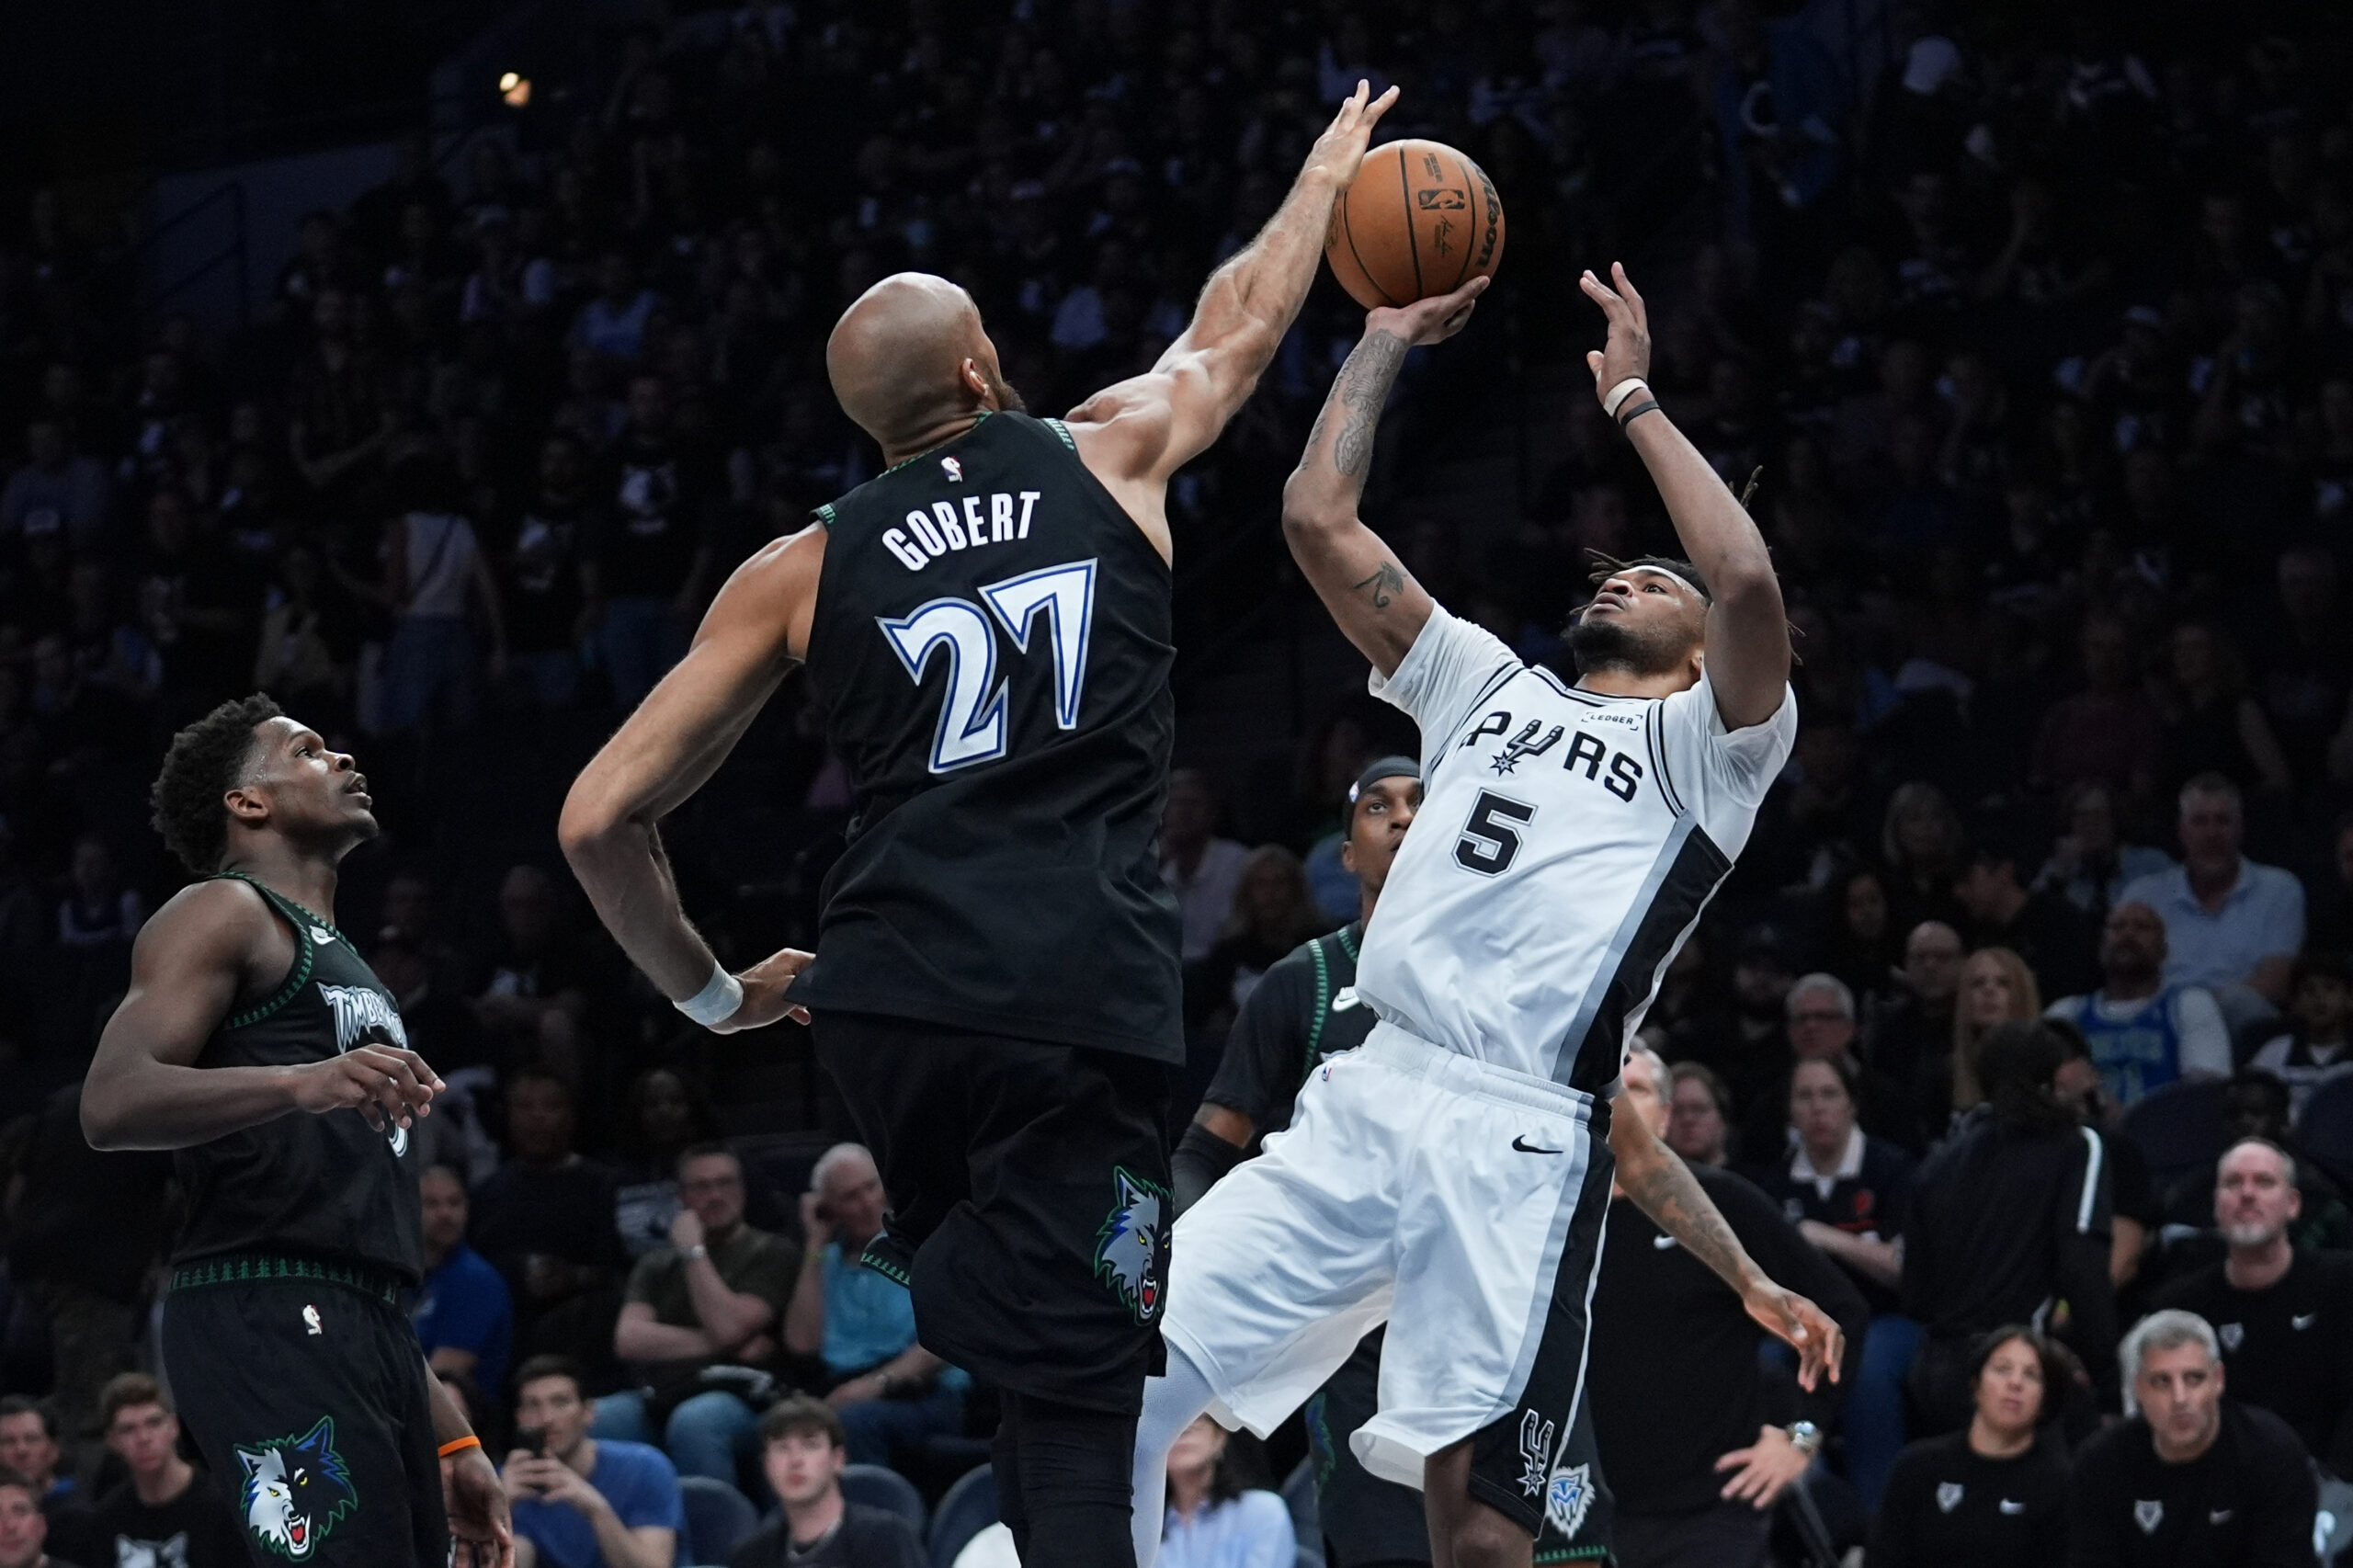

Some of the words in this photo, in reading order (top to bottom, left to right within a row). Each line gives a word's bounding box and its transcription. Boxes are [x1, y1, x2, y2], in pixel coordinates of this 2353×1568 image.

[881, 491, 1041, 572] GOBERT
[874, 557, 1098, 774] 27
[1456, 710, 1643, 803] PURS
[1590, 713, 1633, 726] LEDGER
[1450, 787, 1539, 878] 5
